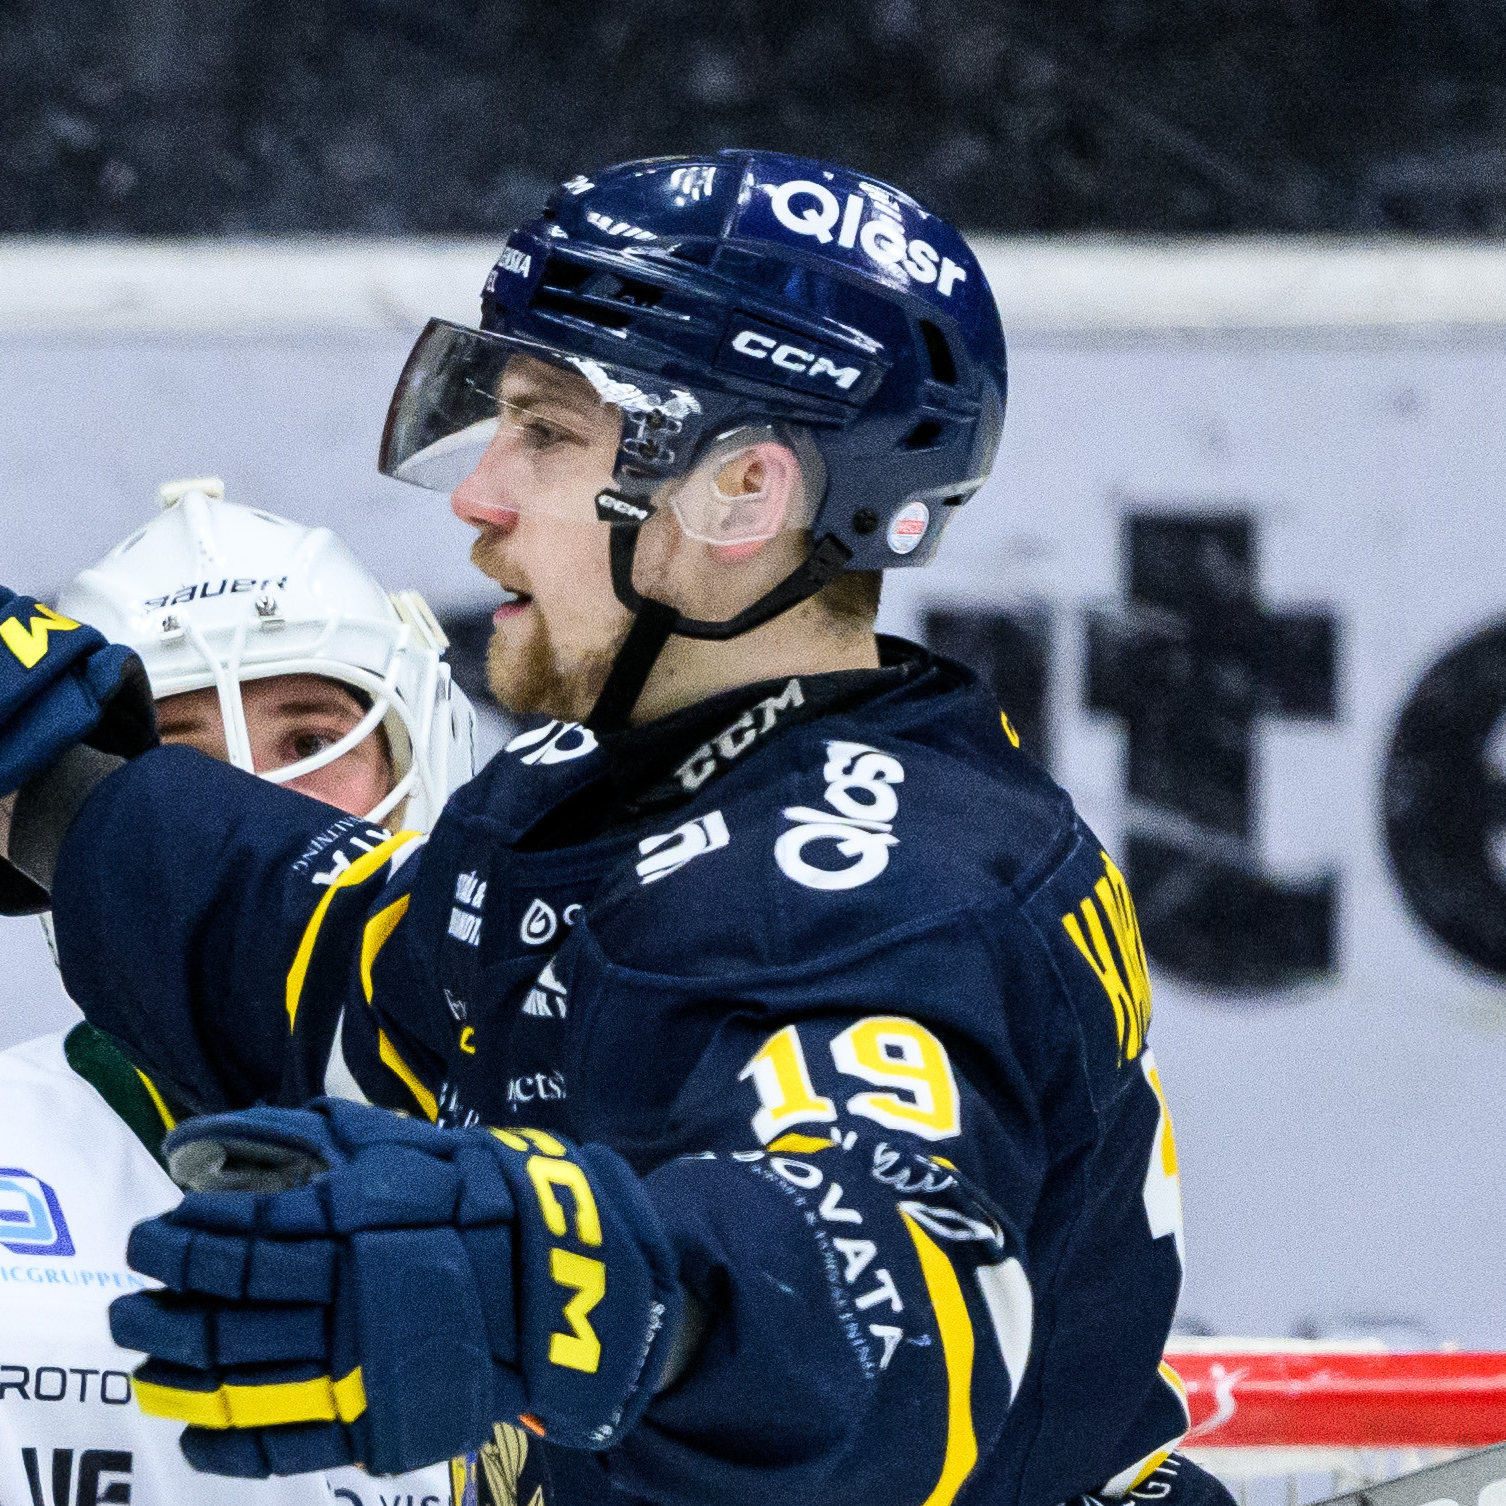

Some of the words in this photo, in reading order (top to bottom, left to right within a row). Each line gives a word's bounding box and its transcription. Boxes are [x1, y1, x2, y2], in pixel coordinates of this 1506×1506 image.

[731, 329, 861, 390] CCM
[674, 678, 805, 792] CCM
[738, 1016, 960, 1145] 19
